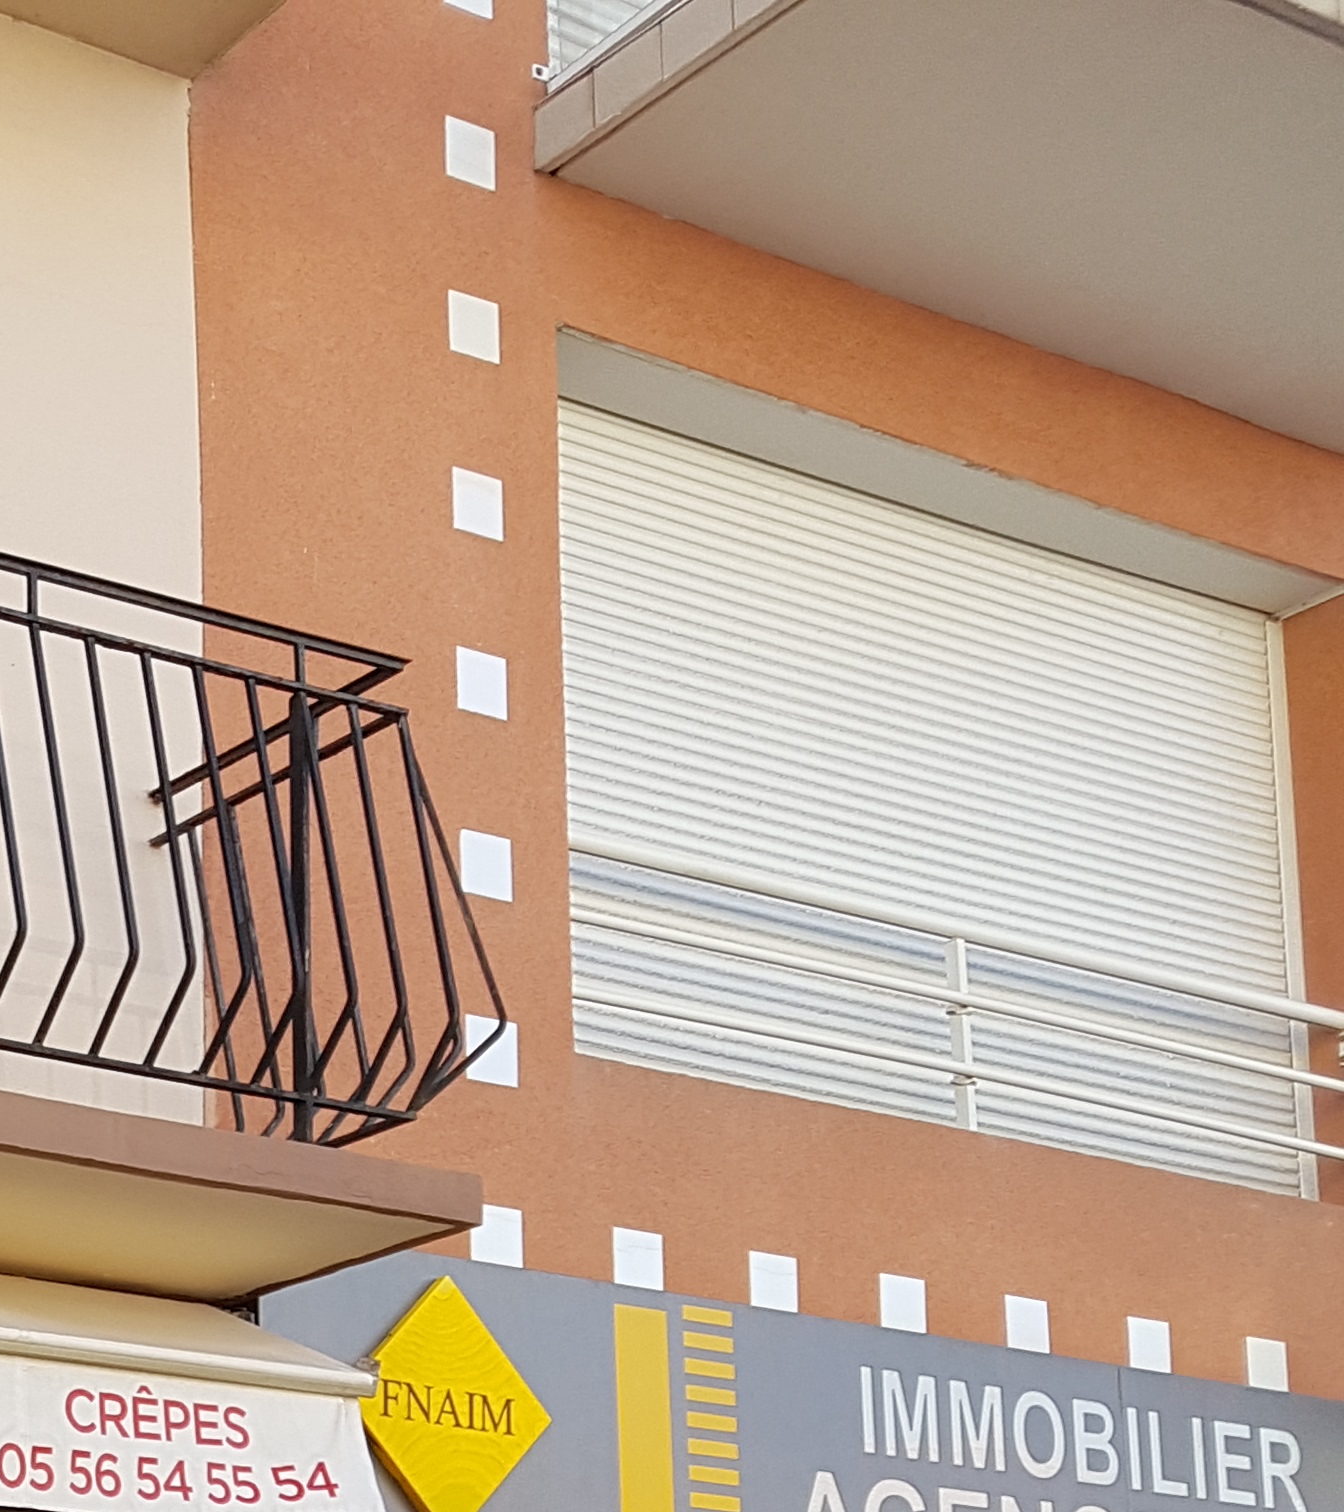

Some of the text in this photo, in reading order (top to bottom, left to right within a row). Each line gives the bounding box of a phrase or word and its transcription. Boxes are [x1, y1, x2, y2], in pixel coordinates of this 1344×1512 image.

[65, 1386, 249, 1449] CRÊPES
[380, 1378, 516, 1437] FNAIM
[69, 1449, 121, 1498] 56
[137, 1456, 193, 1502] 54
[206, 1462, 260, 1504] 55
[271, 1461, 339, 1501] 54
